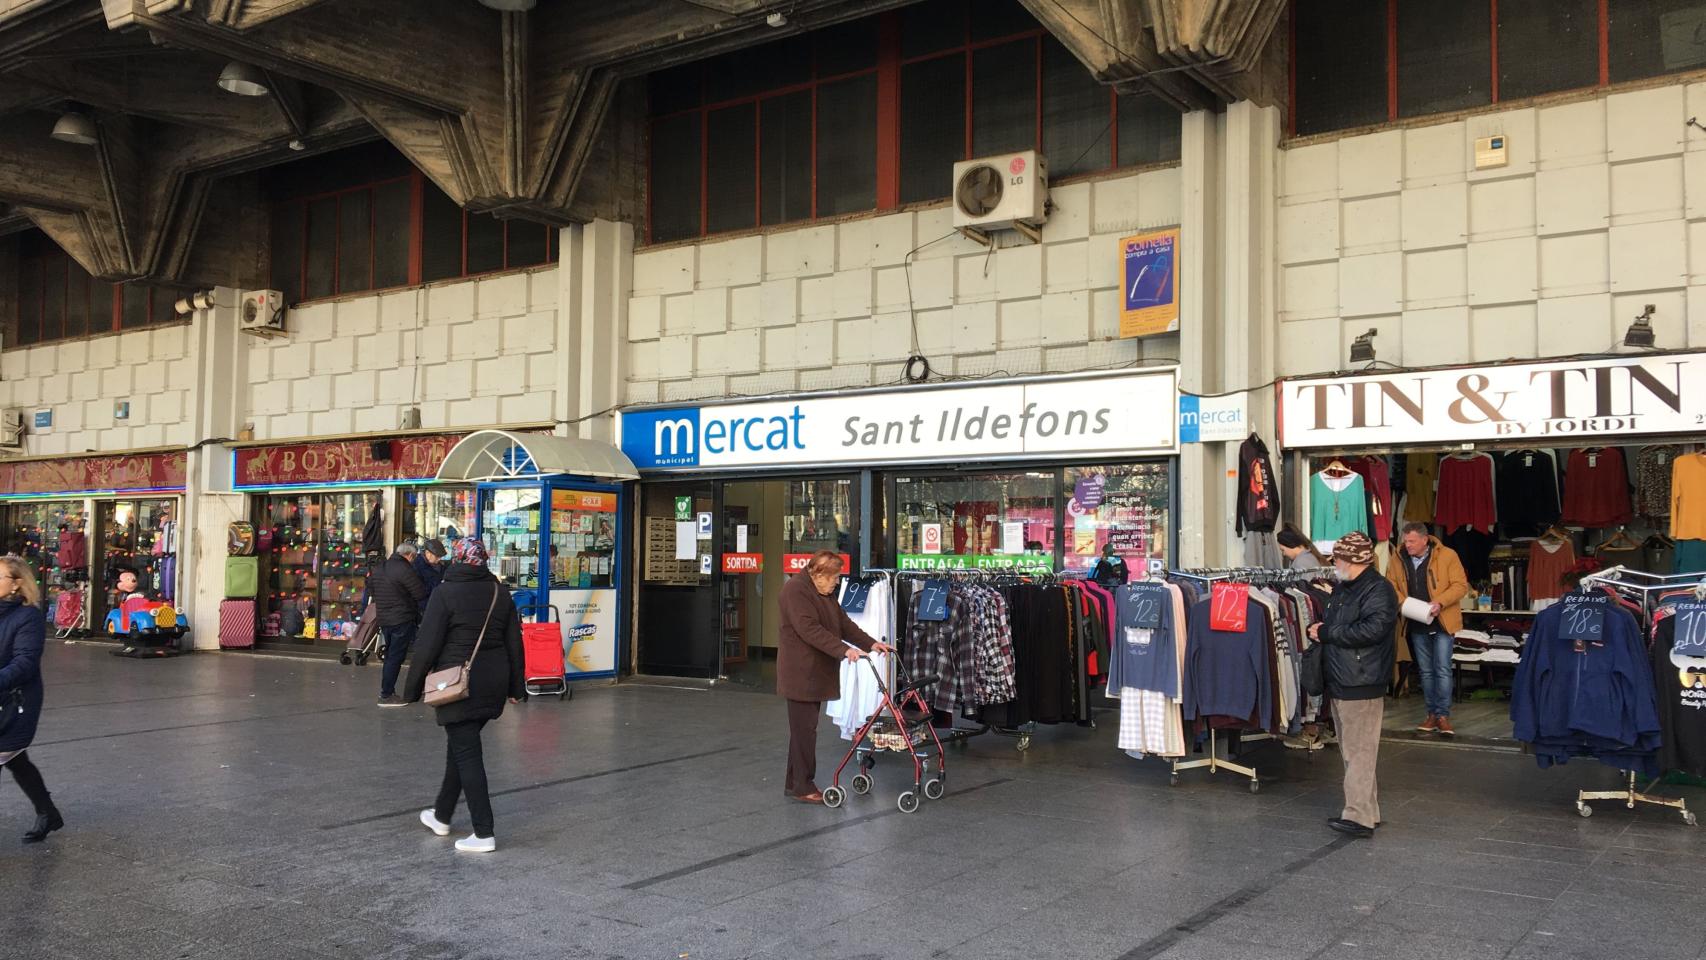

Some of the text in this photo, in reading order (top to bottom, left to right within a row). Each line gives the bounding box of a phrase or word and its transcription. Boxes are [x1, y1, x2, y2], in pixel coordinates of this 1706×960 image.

[1011, 177, 1024, 186] LG
[1296, 361, 1690, 430] TIN & TIN
[1180, 407, 1242, 425] mercat
[655, 405, 806, 456] mercat
[841, 402, 1111, 447] Sant Ildefons
[1496, 417, 1637, 435] BY JORDI
[655, 456, 694, 465] municipal
[677, 512, 691, 520] DEA
[699, 514, 711, 531] P
[702, 556, 711, 569] P
[726, 557, 758, 569] SORTIDA
[978, 559, 1047, 572] ENTRADA
[569, 626, 596, 638] Rascas
